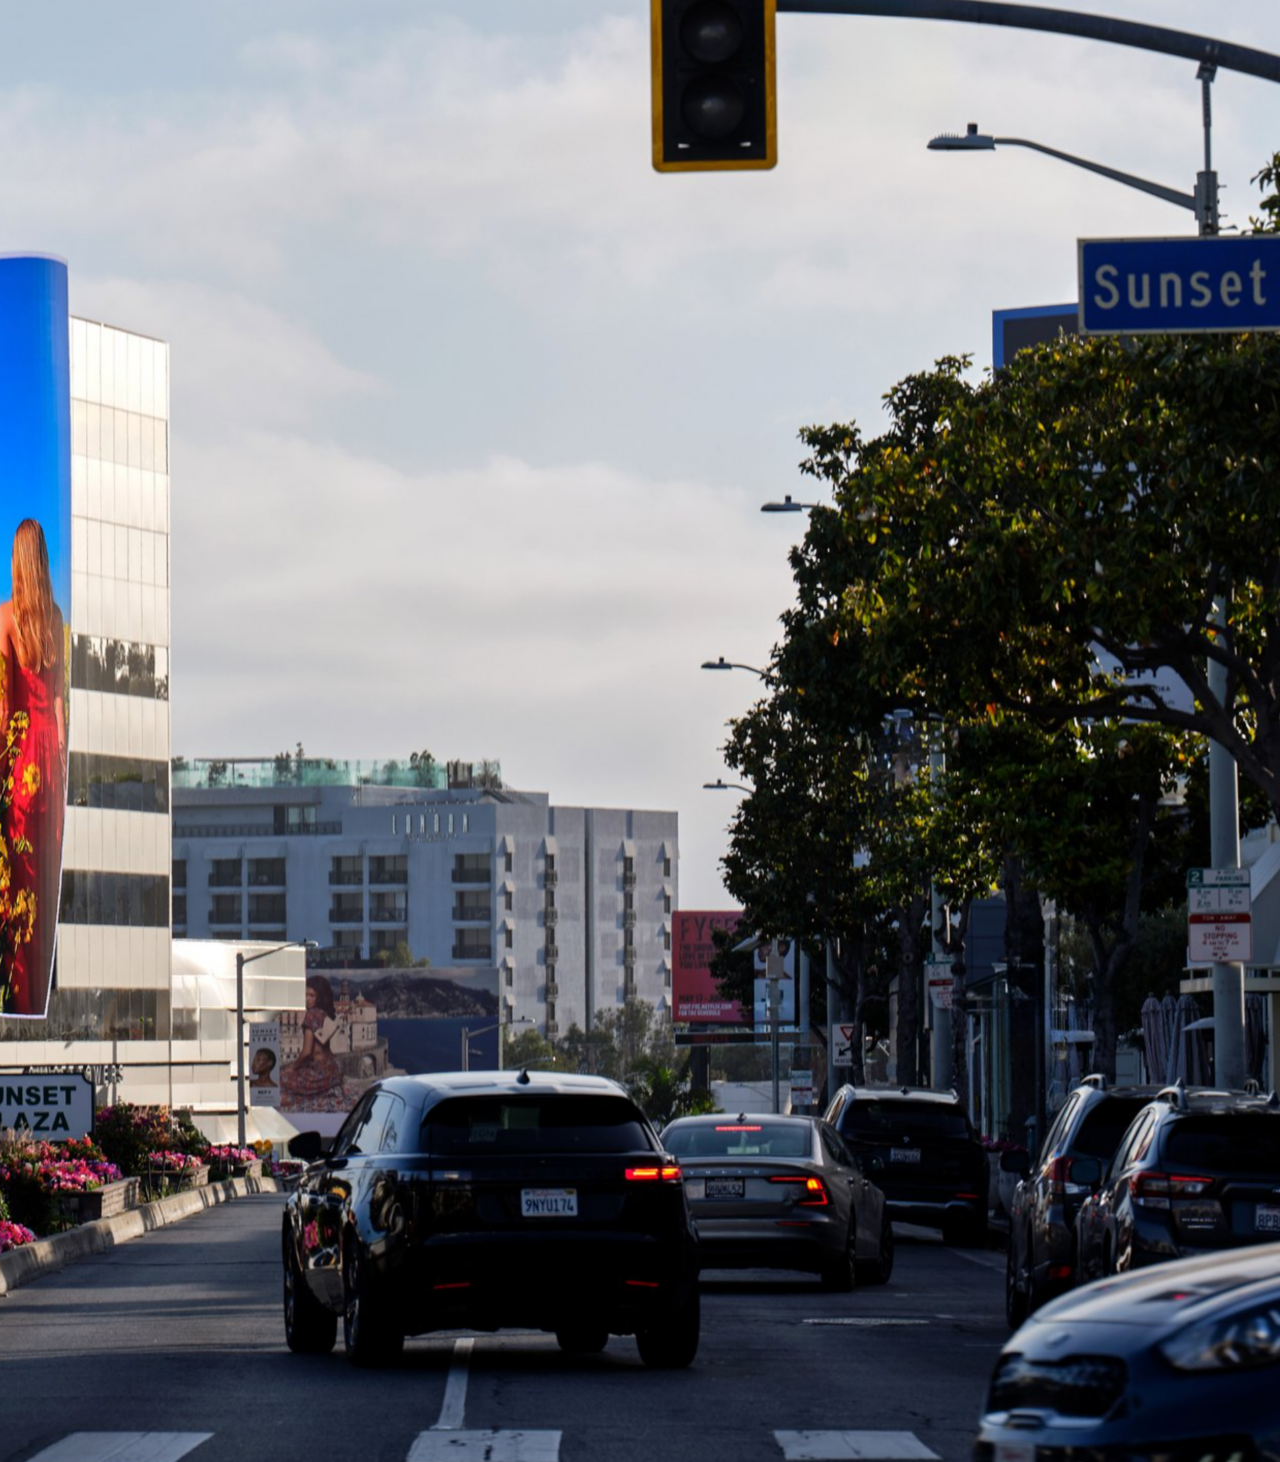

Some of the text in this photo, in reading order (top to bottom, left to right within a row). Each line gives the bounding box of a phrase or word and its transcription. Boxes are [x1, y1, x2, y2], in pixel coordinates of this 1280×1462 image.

[1094, 258, 1267, 310] Sunset
[391, 813, 469, 836] LONDON
[1191, 871, 1200, 882] 2
[1203, 932, 1237, 940] STOPPING
[525, 1198, 574, 1213] 9NYU174
